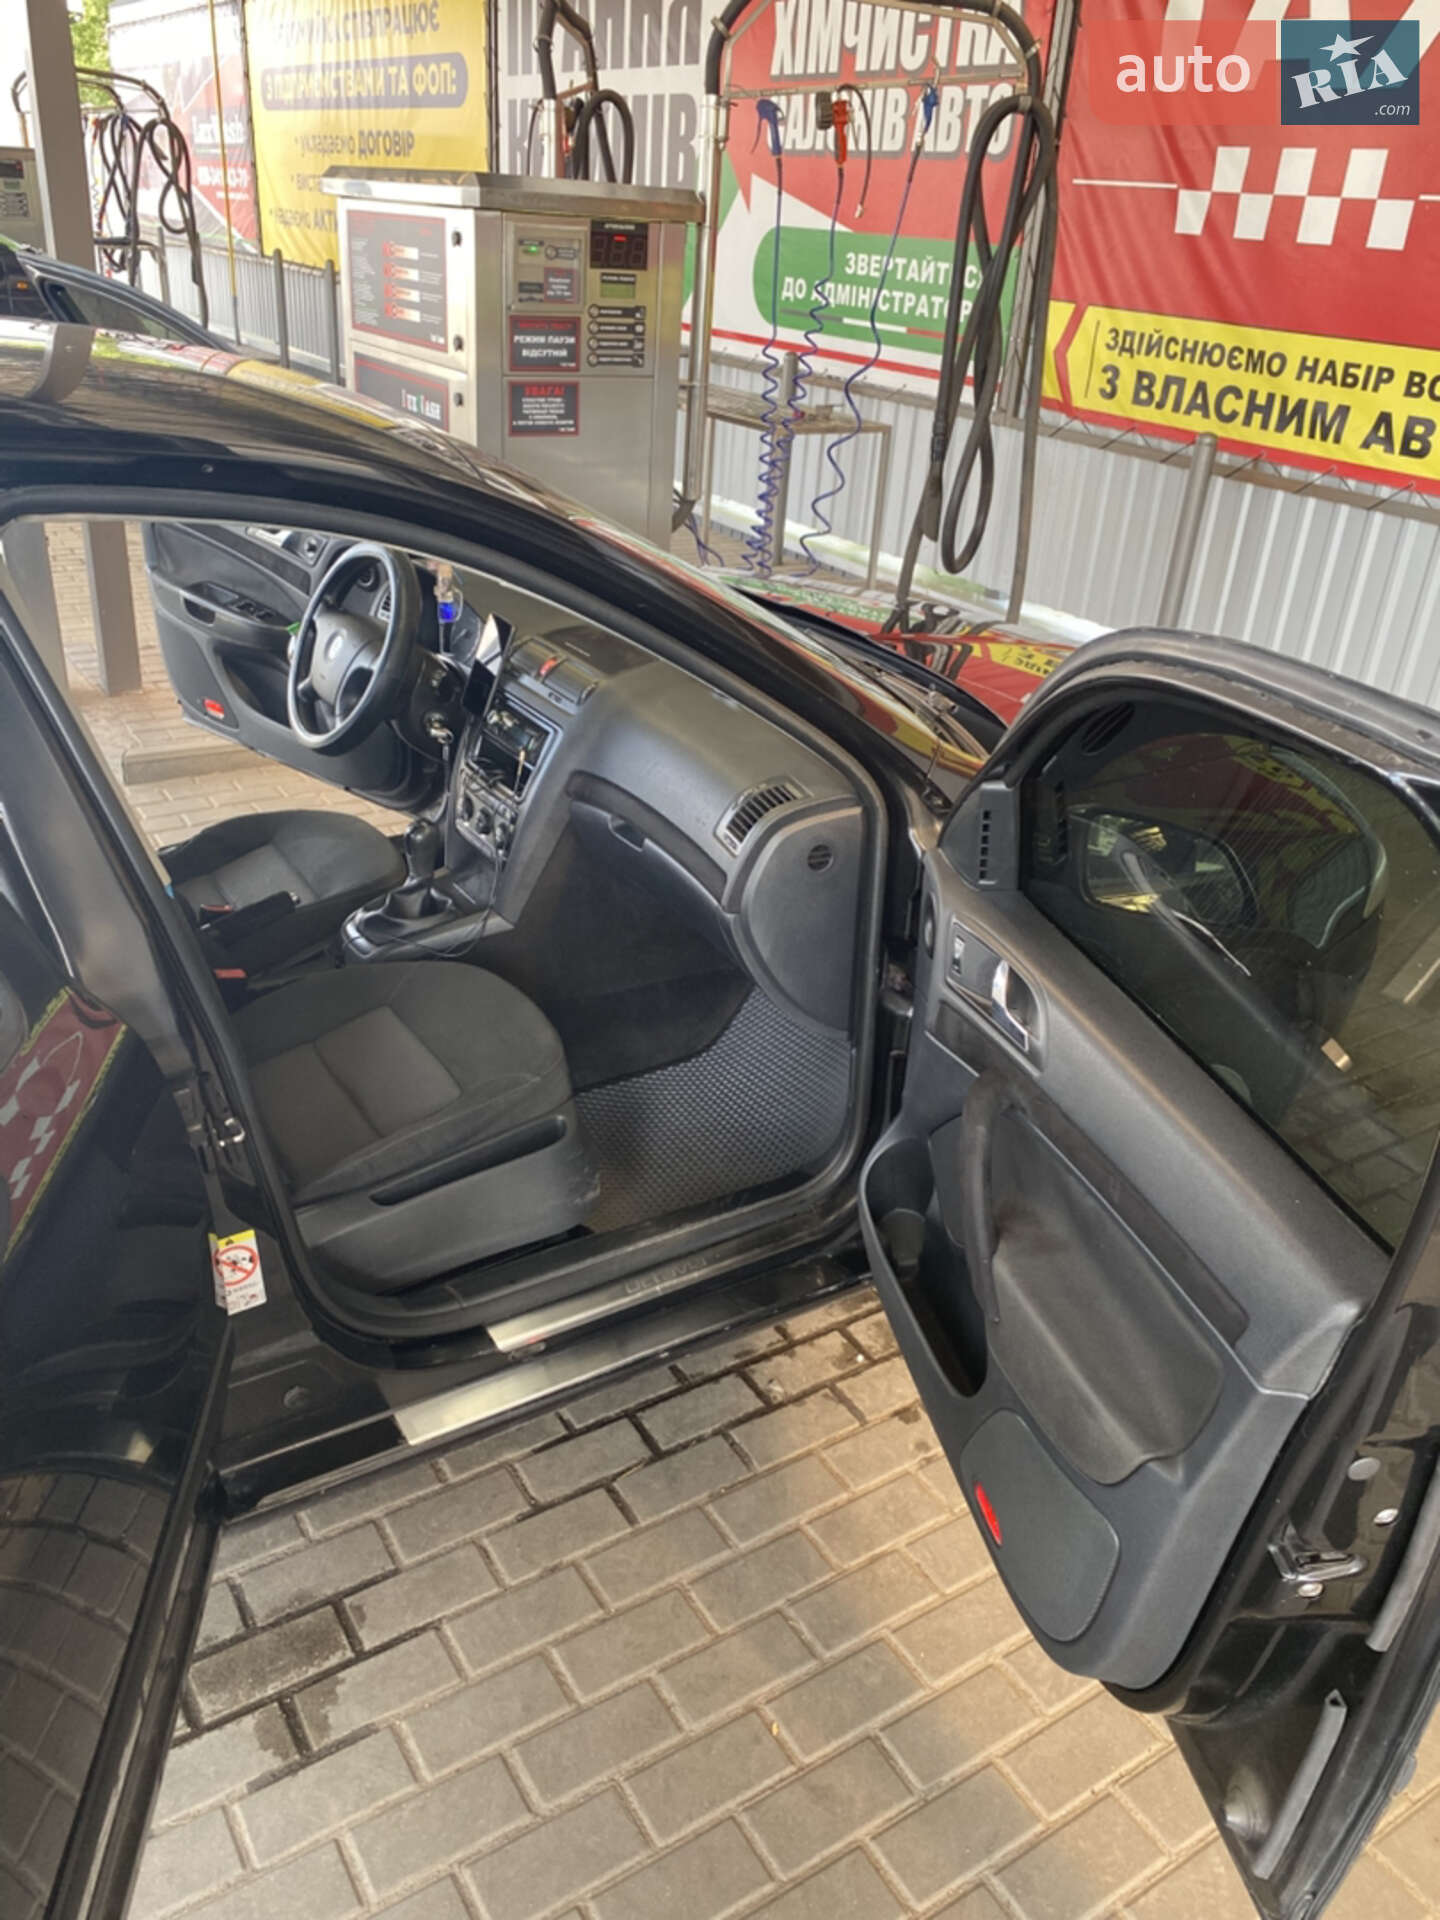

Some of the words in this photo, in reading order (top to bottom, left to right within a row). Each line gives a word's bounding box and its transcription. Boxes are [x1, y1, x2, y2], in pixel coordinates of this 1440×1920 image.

[388, 65, 409, 97] ТА
[412, 62, 457, 97] ФОП:
[358, 128, 416, 158] ДОГОВІР
[781, 276, 808, 302] ДО
[1104, 327, 1288, 378] ЗДІЙСНЮЄМО
[1295, 355, 1396, 393] НАБІР
[1099, 364, 1121, 400] З
[1131, 369, 1352, 445] ВЛАСНИМ
[1359, 410, 1438, 460] АВ
